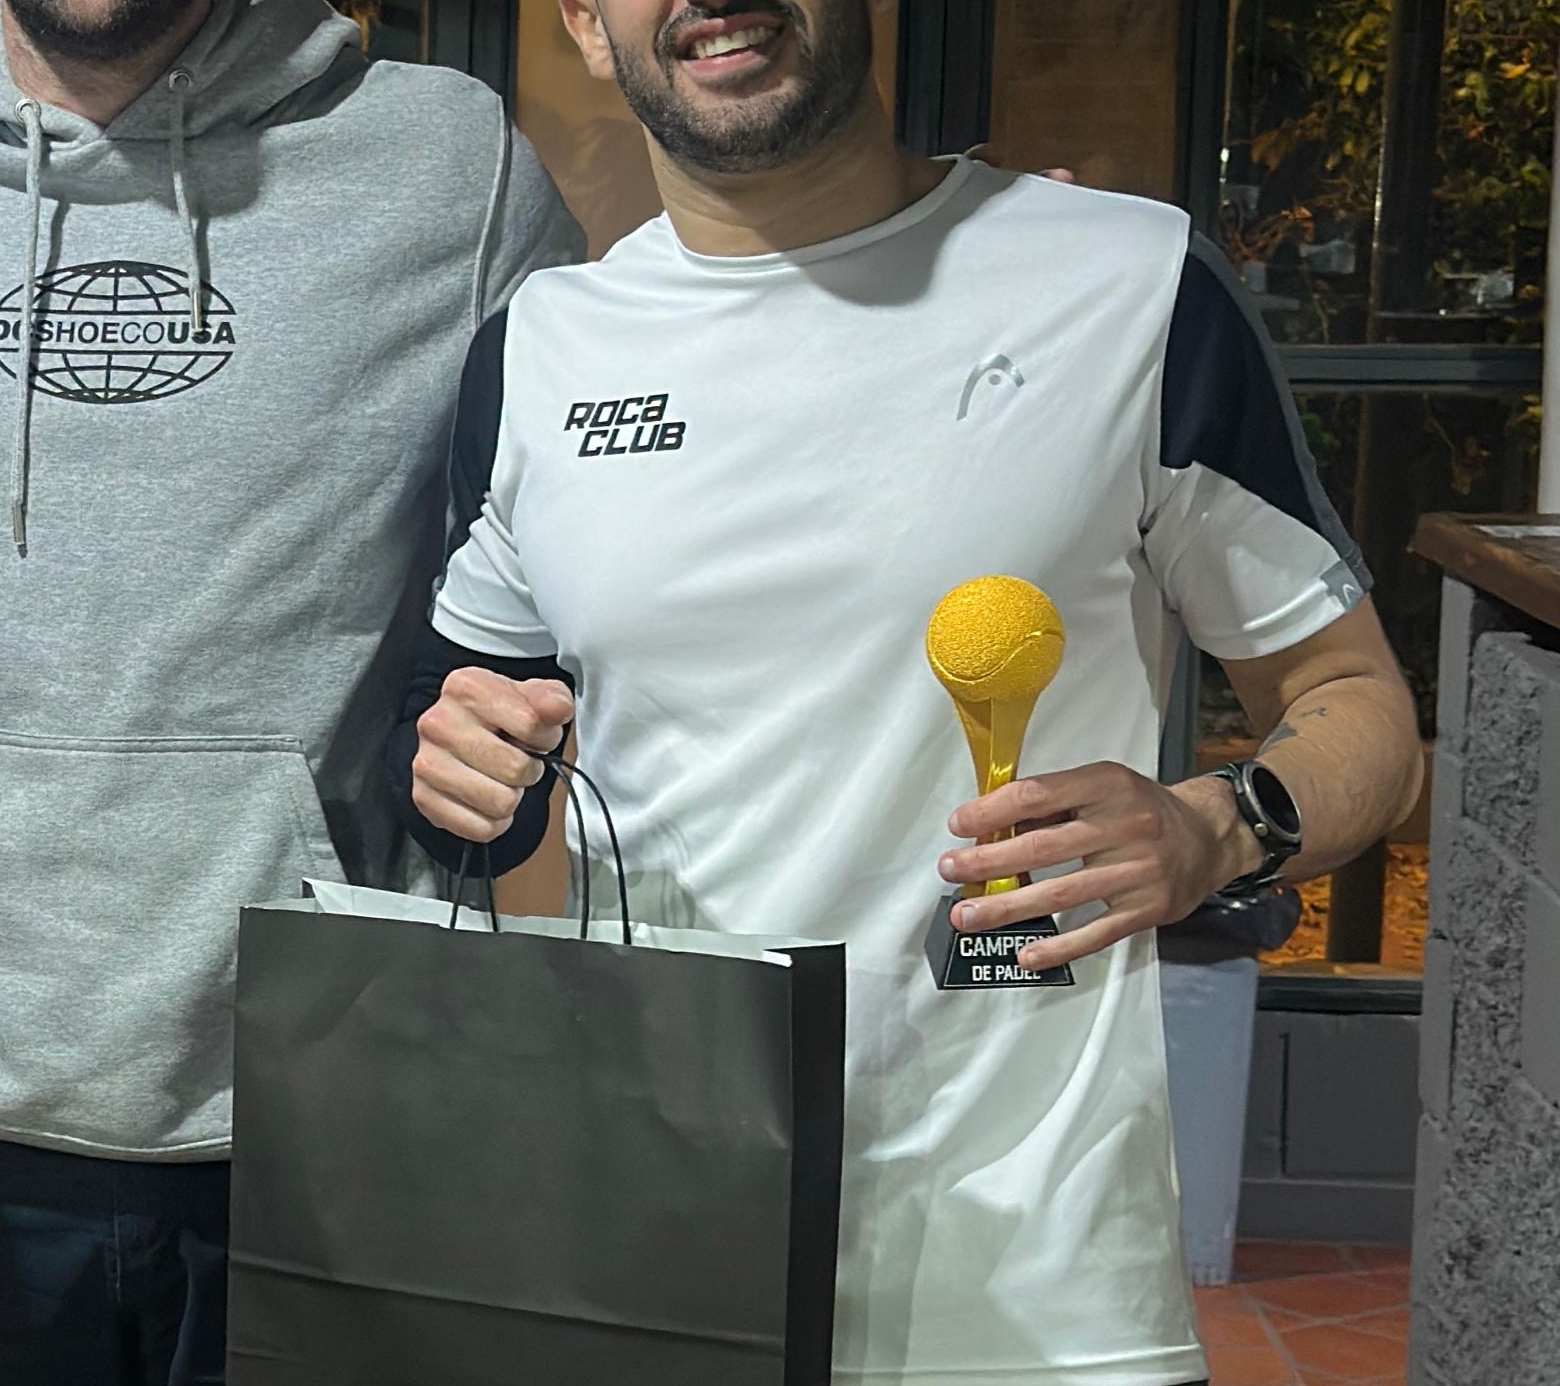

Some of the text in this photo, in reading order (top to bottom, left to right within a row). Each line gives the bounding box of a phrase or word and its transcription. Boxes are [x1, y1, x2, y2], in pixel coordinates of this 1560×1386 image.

[577, 421, 686, 457] CLUB
[959, 936, 1048, 957] CAMPE
[972, 965, 991, 981] DE
